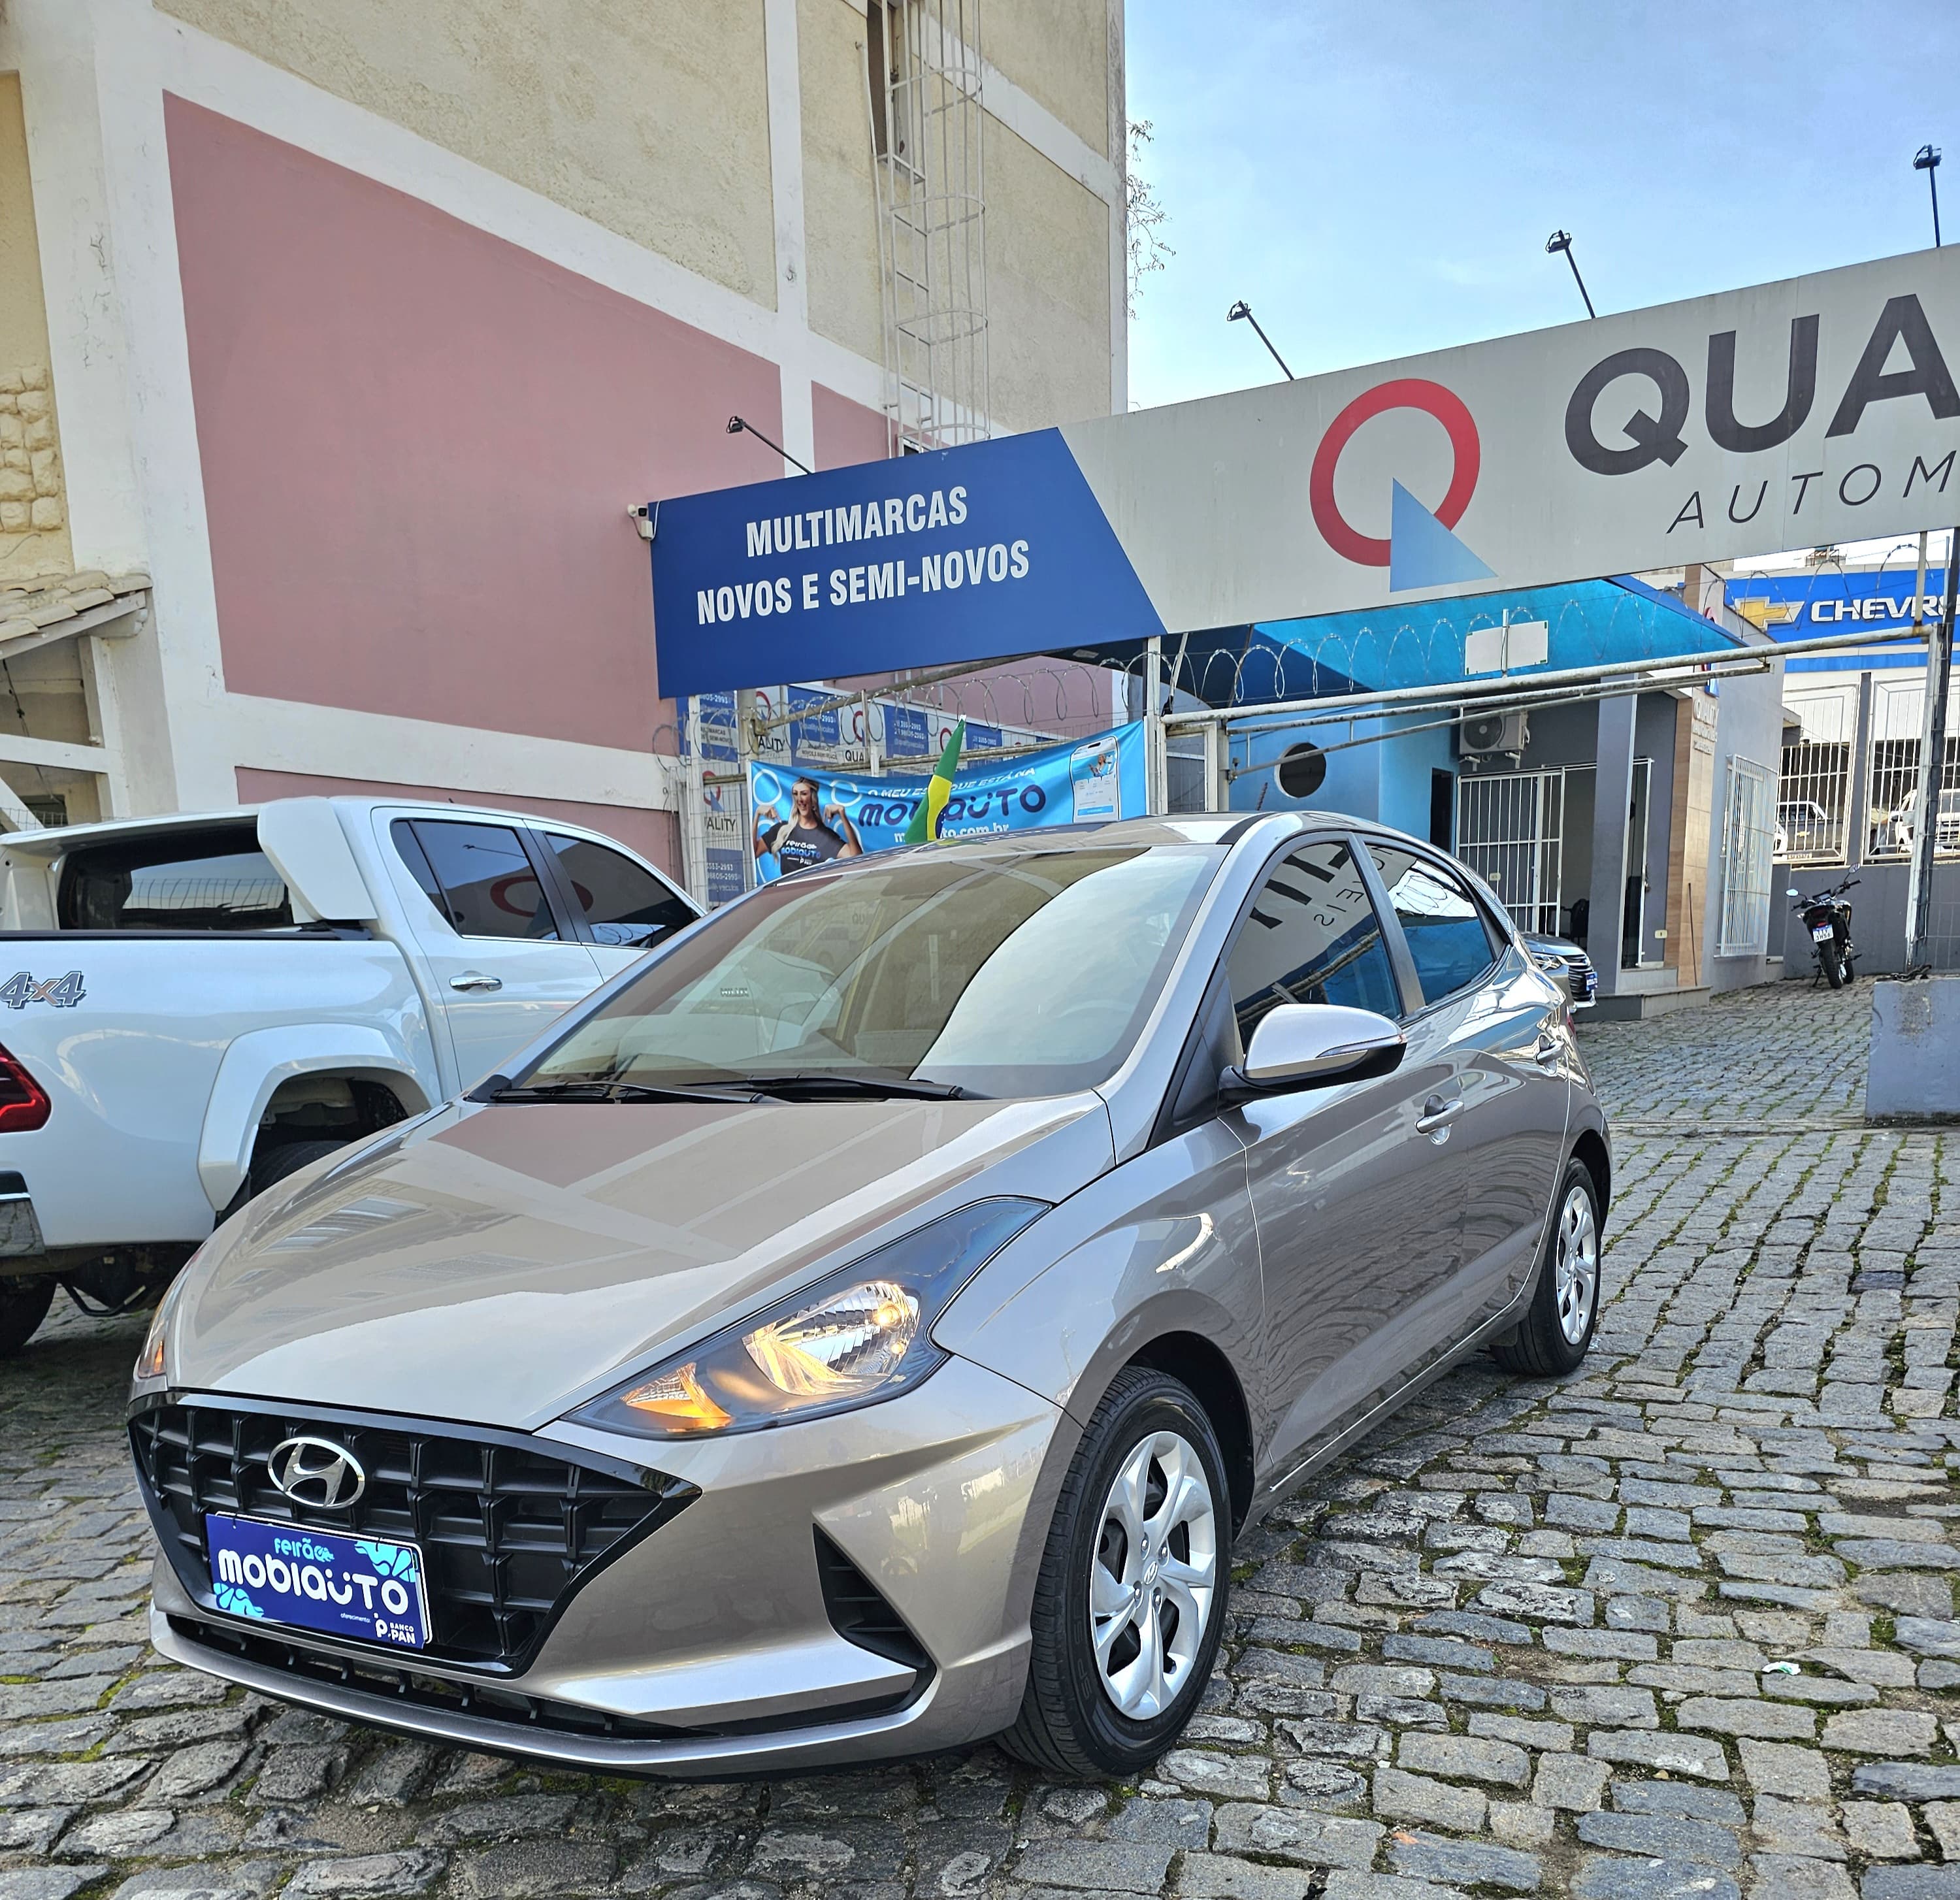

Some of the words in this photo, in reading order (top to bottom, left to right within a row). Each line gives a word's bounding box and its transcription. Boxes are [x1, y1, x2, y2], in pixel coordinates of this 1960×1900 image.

[1565, 294, 1960, 476] QUA
[1666, 451, 1957, 534] AUTOM
[746, 485, 968, 557] MULTIMARCAS
[696, 577, 792, 625] NOVOS
[803, 573, 820, 610] E
[829, 540, 1030, 605] SEMI-NOVOS
[759, 736, 786, 752] ALITY
[881, 789, 911, 798] MEU
[704, 816, 736, 832] ALITY
[0, 971, 86, 1009] 4x4
[389, 1622, 414, 1633] BANCO
